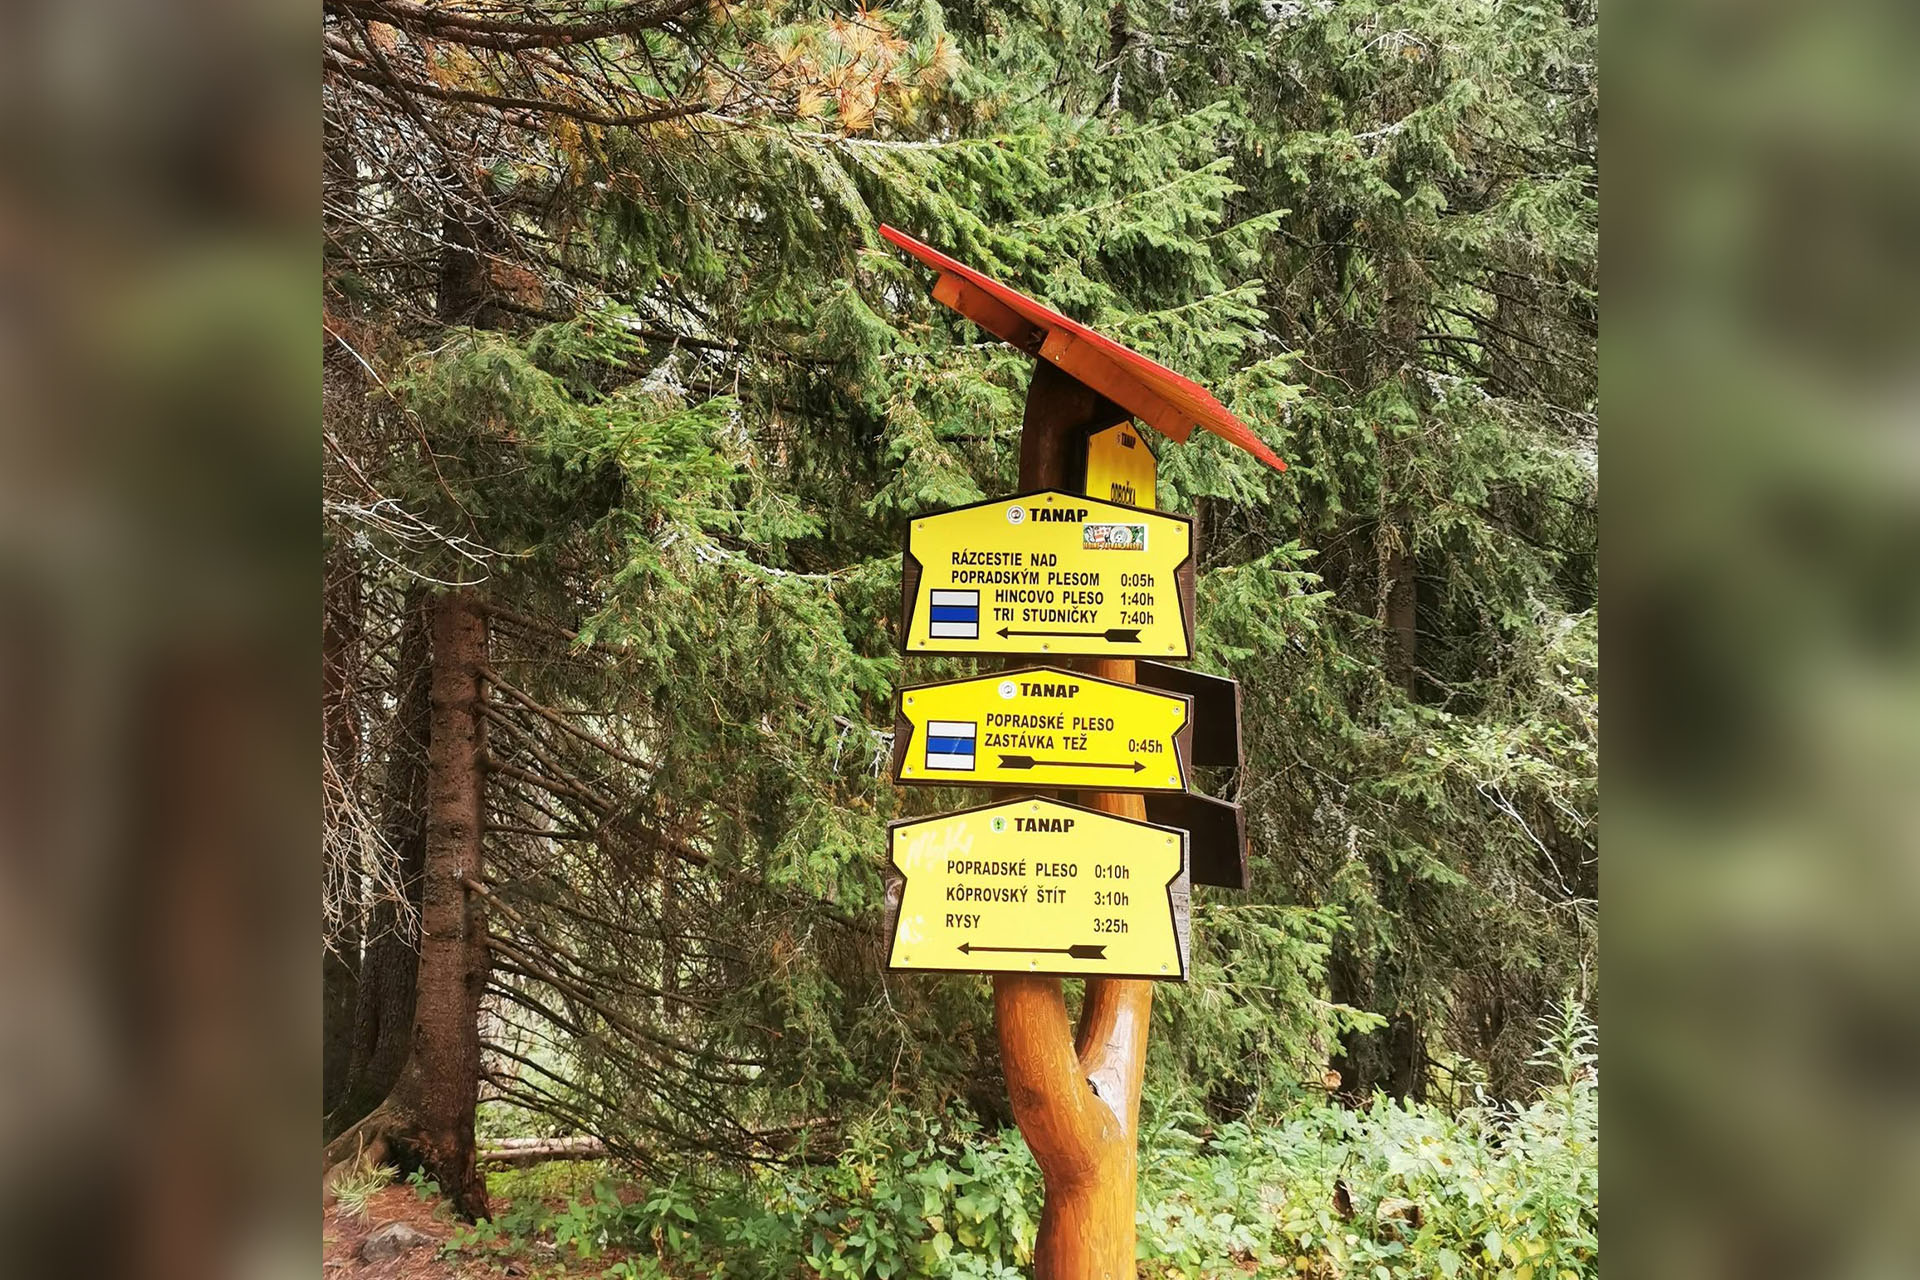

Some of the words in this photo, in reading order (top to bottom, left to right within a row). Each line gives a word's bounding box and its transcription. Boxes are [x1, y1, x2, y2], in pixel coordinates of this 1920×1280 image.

[1029, 509, 1088, 522] TANAP
[952, 549, 1022, 566] RÁZCESTIE
[1031, 553, 1057, 566] NAD
[952, 568, 1039, 585] POPRADSKÝM
[1048, 572, 1099, 585] PLESOM
[1121, 574, 1154, 587] 0:05h
[996, 590, 1054, 604] HINCOVO
[1063, 591, 1103, 604] PLESO
[1121, 592, 1154, 606] 1:40h
[994, 607, 1014, 621] TRI
[1023, 607, 1097, 623] STUDNIČKY
[1120, 611, 1154, 625] 7:40h
[1021, 683, 1079, 698] TANAP
[987, 712, 1064, 729] POPRADSKÉ
[1073, 718, 1114, 731] PLESO
[985, 731, 1054, 749] ZASTÁVKA
[1063, 735, 1087, 751] TEŽ
[1129, 738, 1163, 753] 0:45h
[1014, 818, 1074, 832] TANAP
[947, 859, 1026, 876] POPRADSKÉ
[1036, 862, 1078, 878] PLESO
[1095, 864, 1129, 879] 0:10h
[946, 884, 1028, 902] KÔPROVSKÝ
[1037, 885, 1066, 904] ŠTÍT
[1094, 892, 1128, 906] 3:10h
[946, 914, 980, 928] RYSY
[1094, 918, 1128, 933] 3:25h
